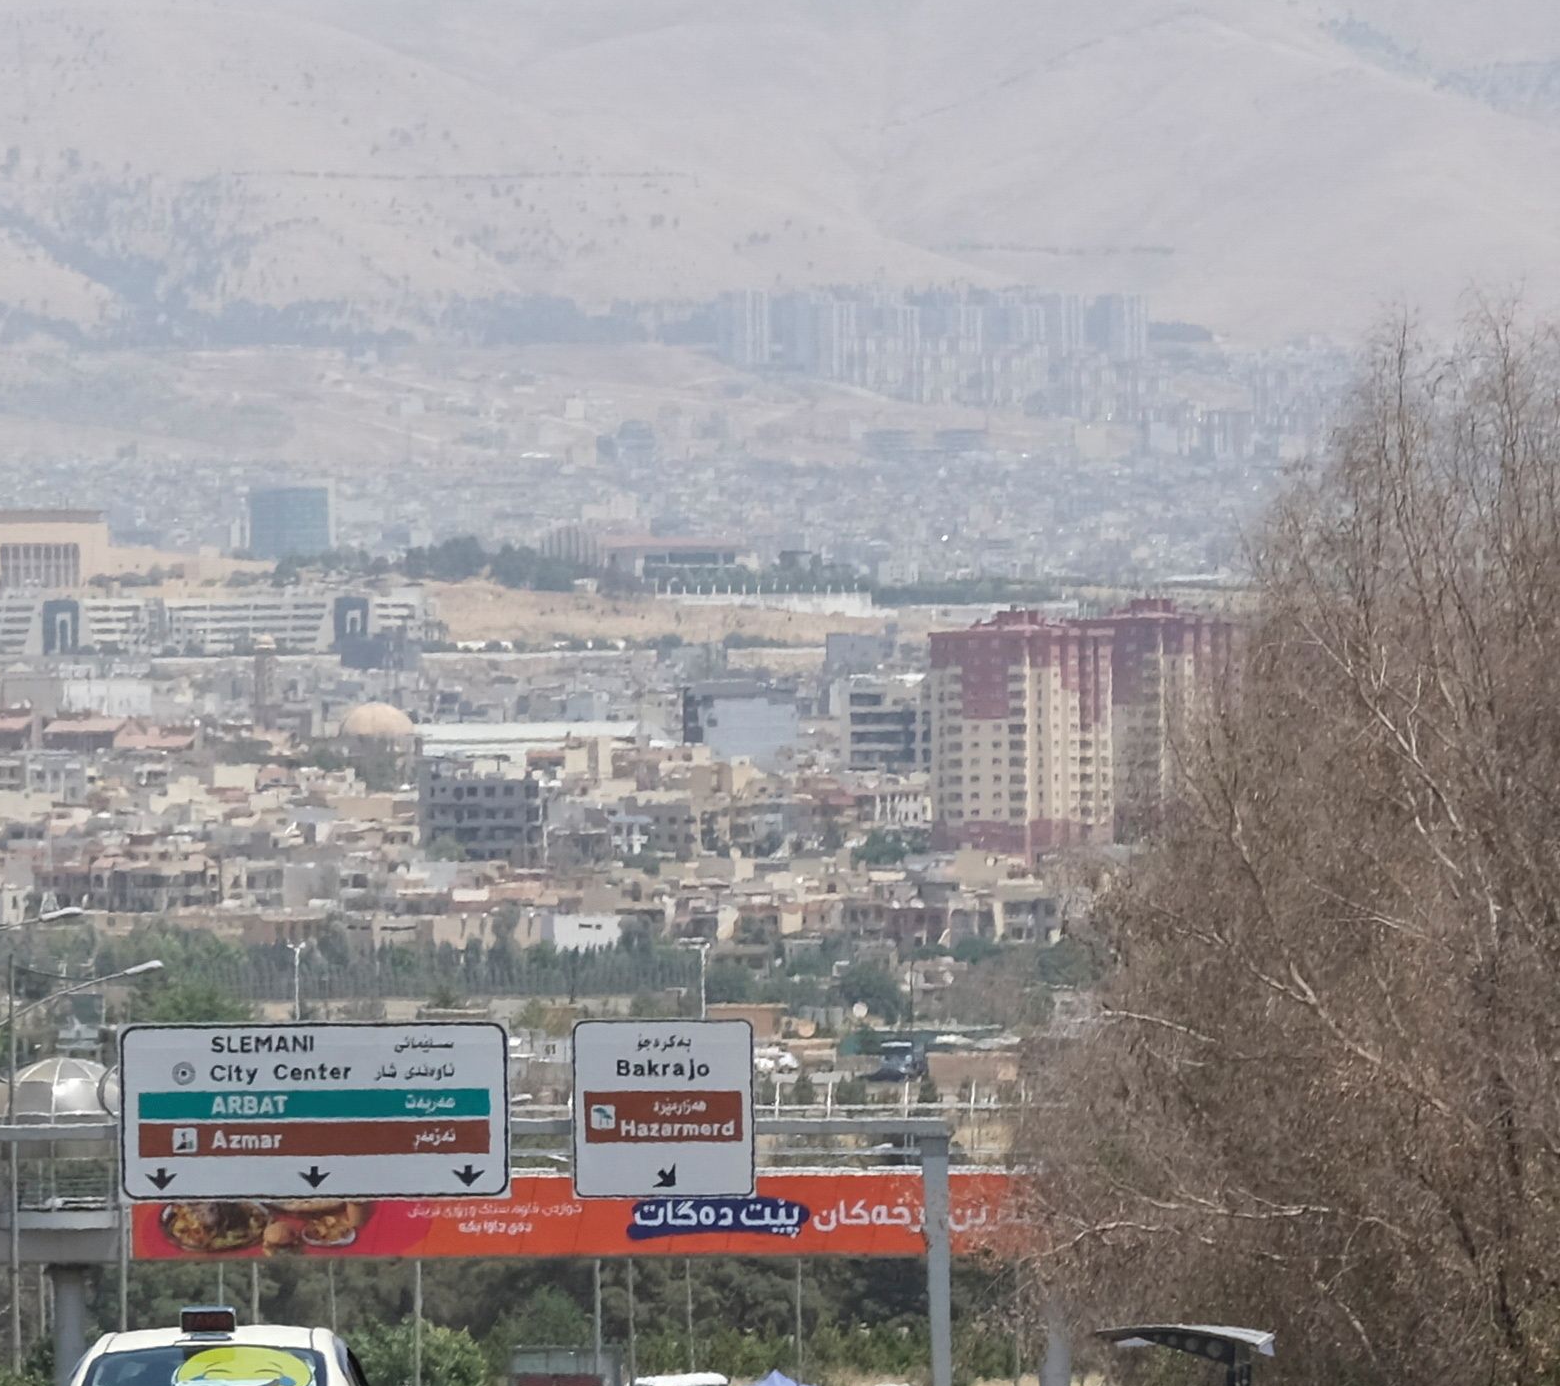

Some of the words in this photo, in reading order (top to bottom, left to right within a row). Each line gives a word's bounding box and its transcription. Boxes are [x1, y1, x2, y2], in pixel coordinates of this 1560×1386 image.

[210, 1035, 314, 1054] SLEMANI
[210, 1064, 259, 1085] City
[273, 1063, 352, 1082] Center
[616, 1058, 710, 1081] Bakrajo
[211, 1095, 288, 1115] ARBAT
[620, 1118, 736, 1138] Hazarmerd
[211, 1129, 283, 1150] Azmar
[633, 1199, 734, 1228] دەگات
